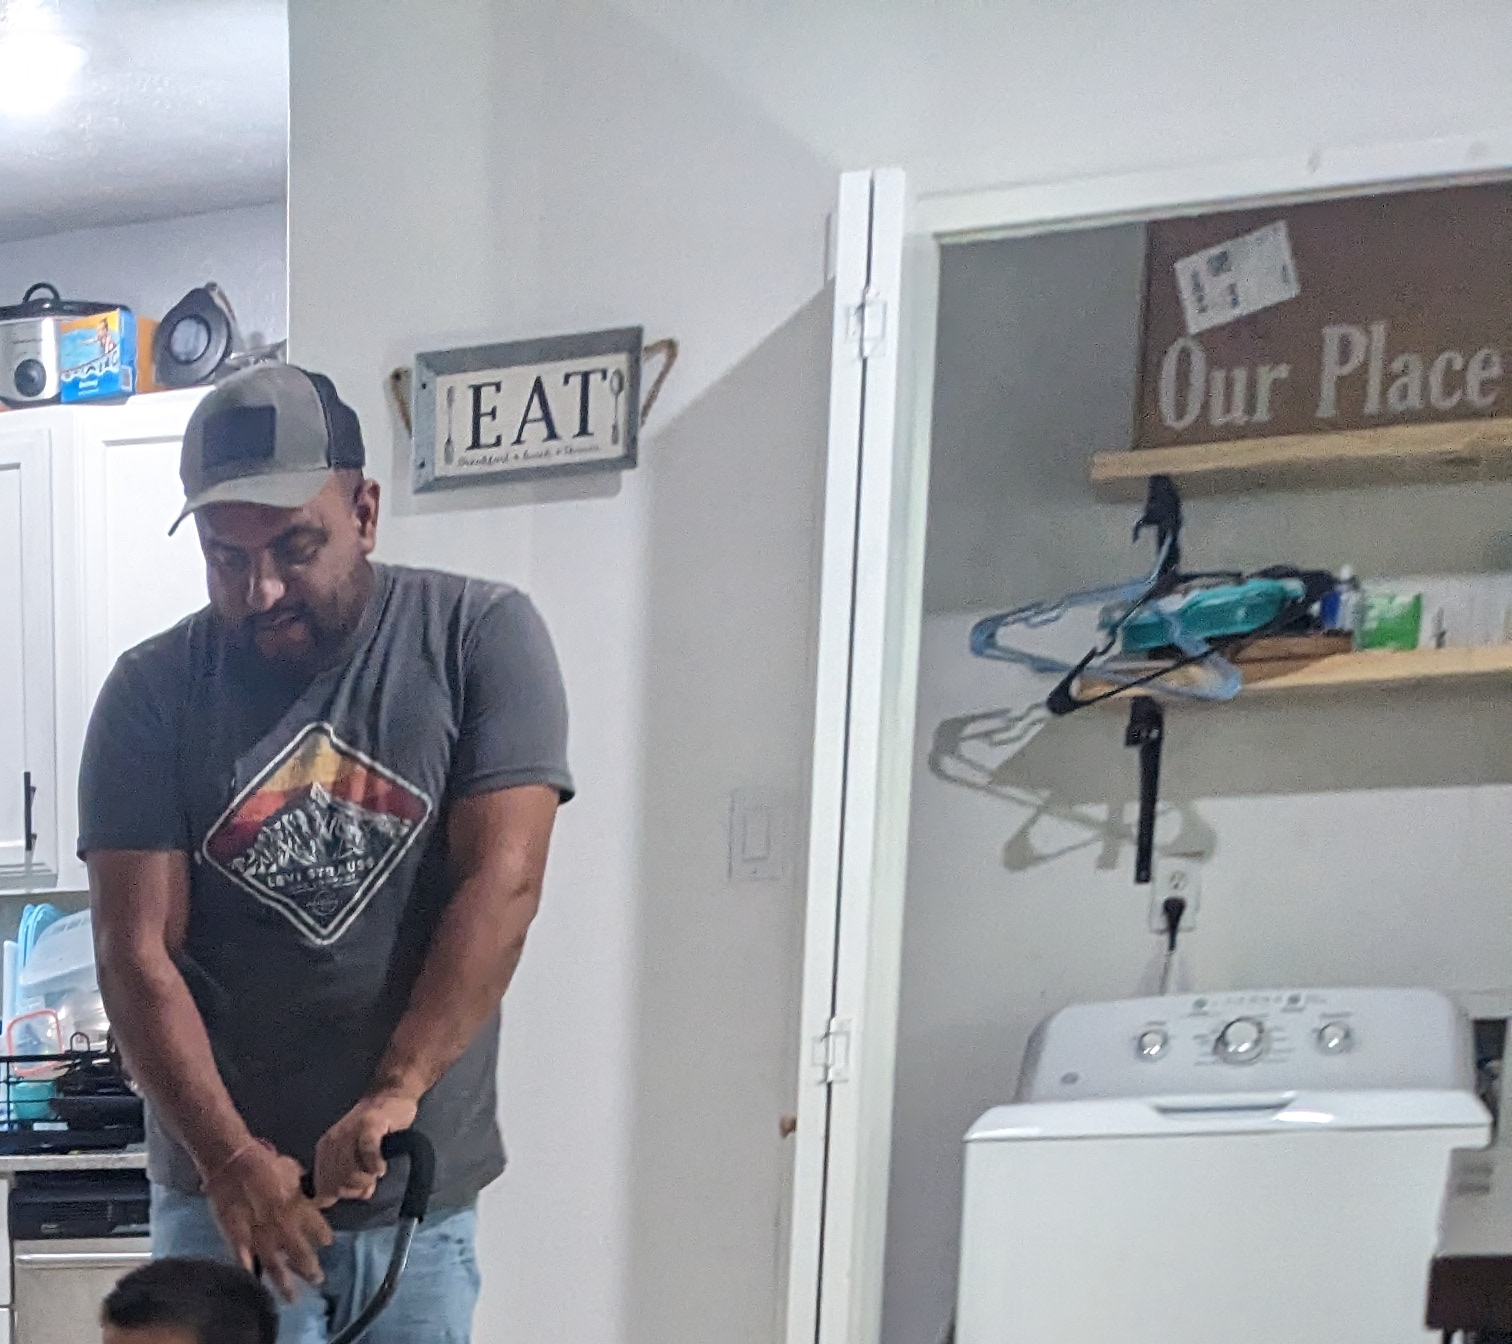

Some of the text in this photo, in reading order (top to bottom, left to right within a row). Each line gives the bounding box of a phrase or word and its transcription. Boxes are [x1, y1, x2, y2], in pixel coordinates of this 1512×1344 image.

[465, 368, 607, 450] EAT
[1158, 319, 1504, 431] Our Place
